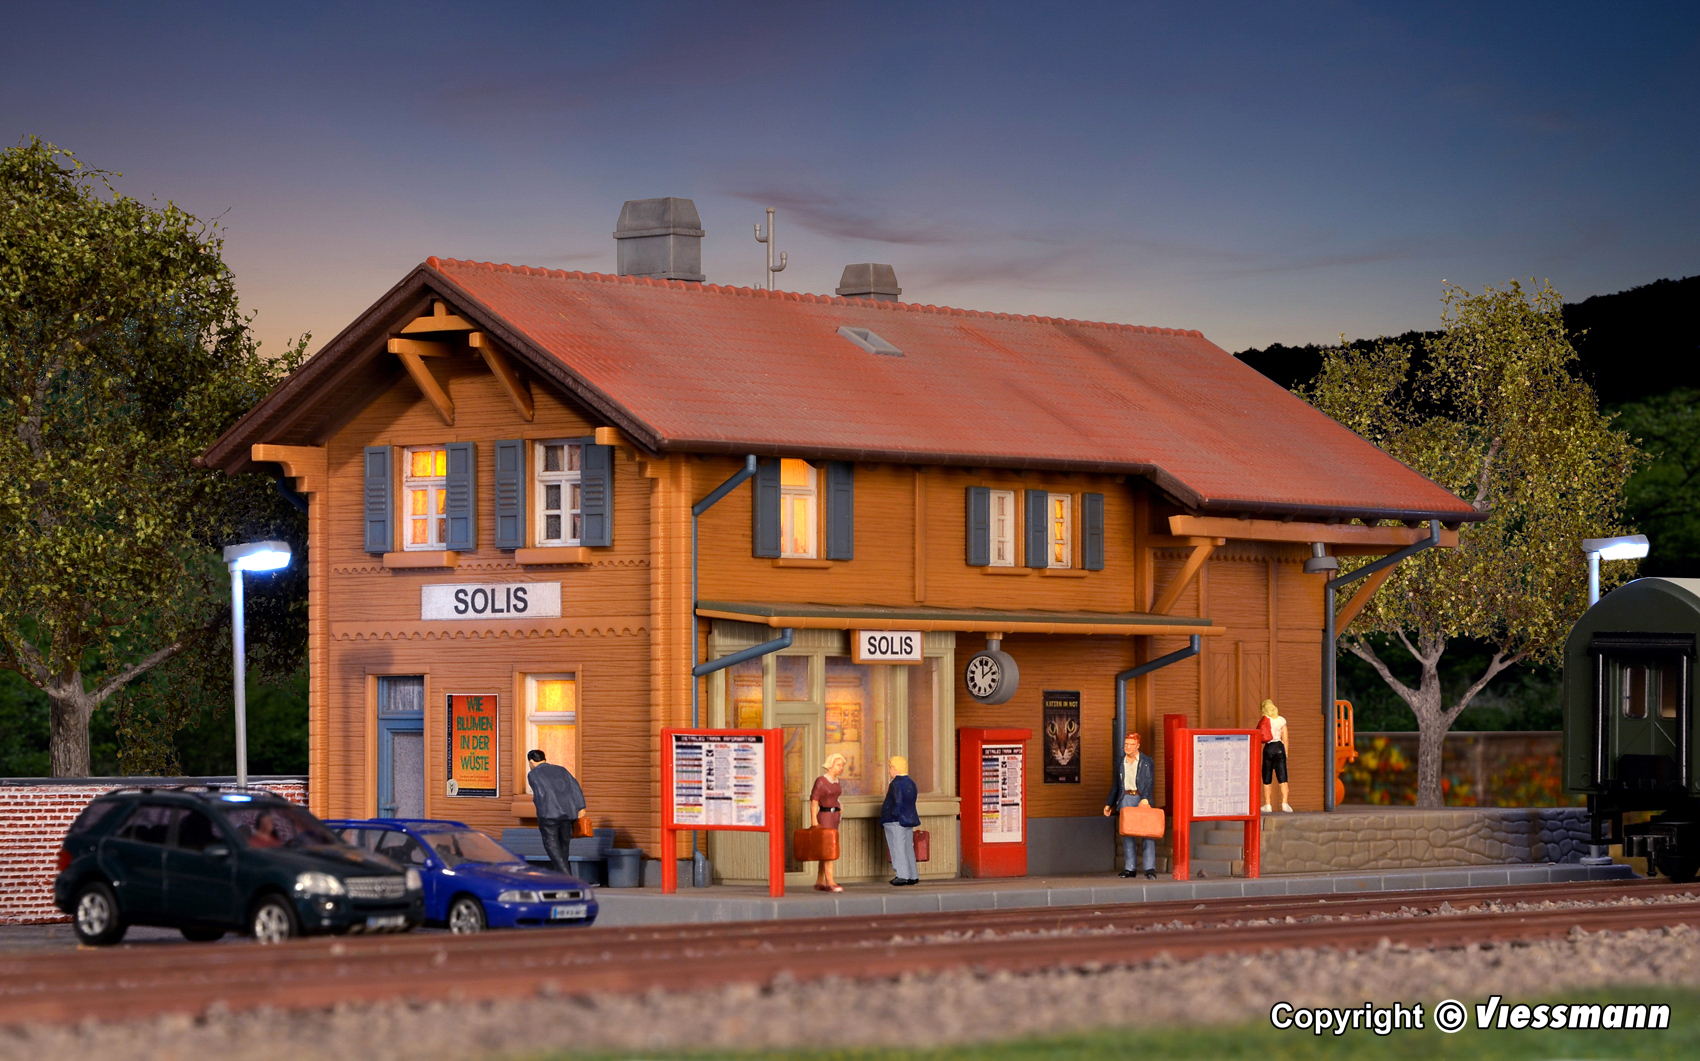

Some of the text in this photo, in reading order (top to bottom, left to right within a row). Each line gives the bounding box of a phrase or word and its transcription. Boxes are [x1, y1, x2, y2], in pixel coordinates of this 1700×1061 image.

[454, 587, 528, 614] SOLIS
[867, 635, 913, 655] SOLIS
[466, 696, 483, 712] WIE
[456, 715, 493, 731] BLUMEN
[460, 735, 490, 750] IN DER
[460, 751, 490, 771] WÜSTE
